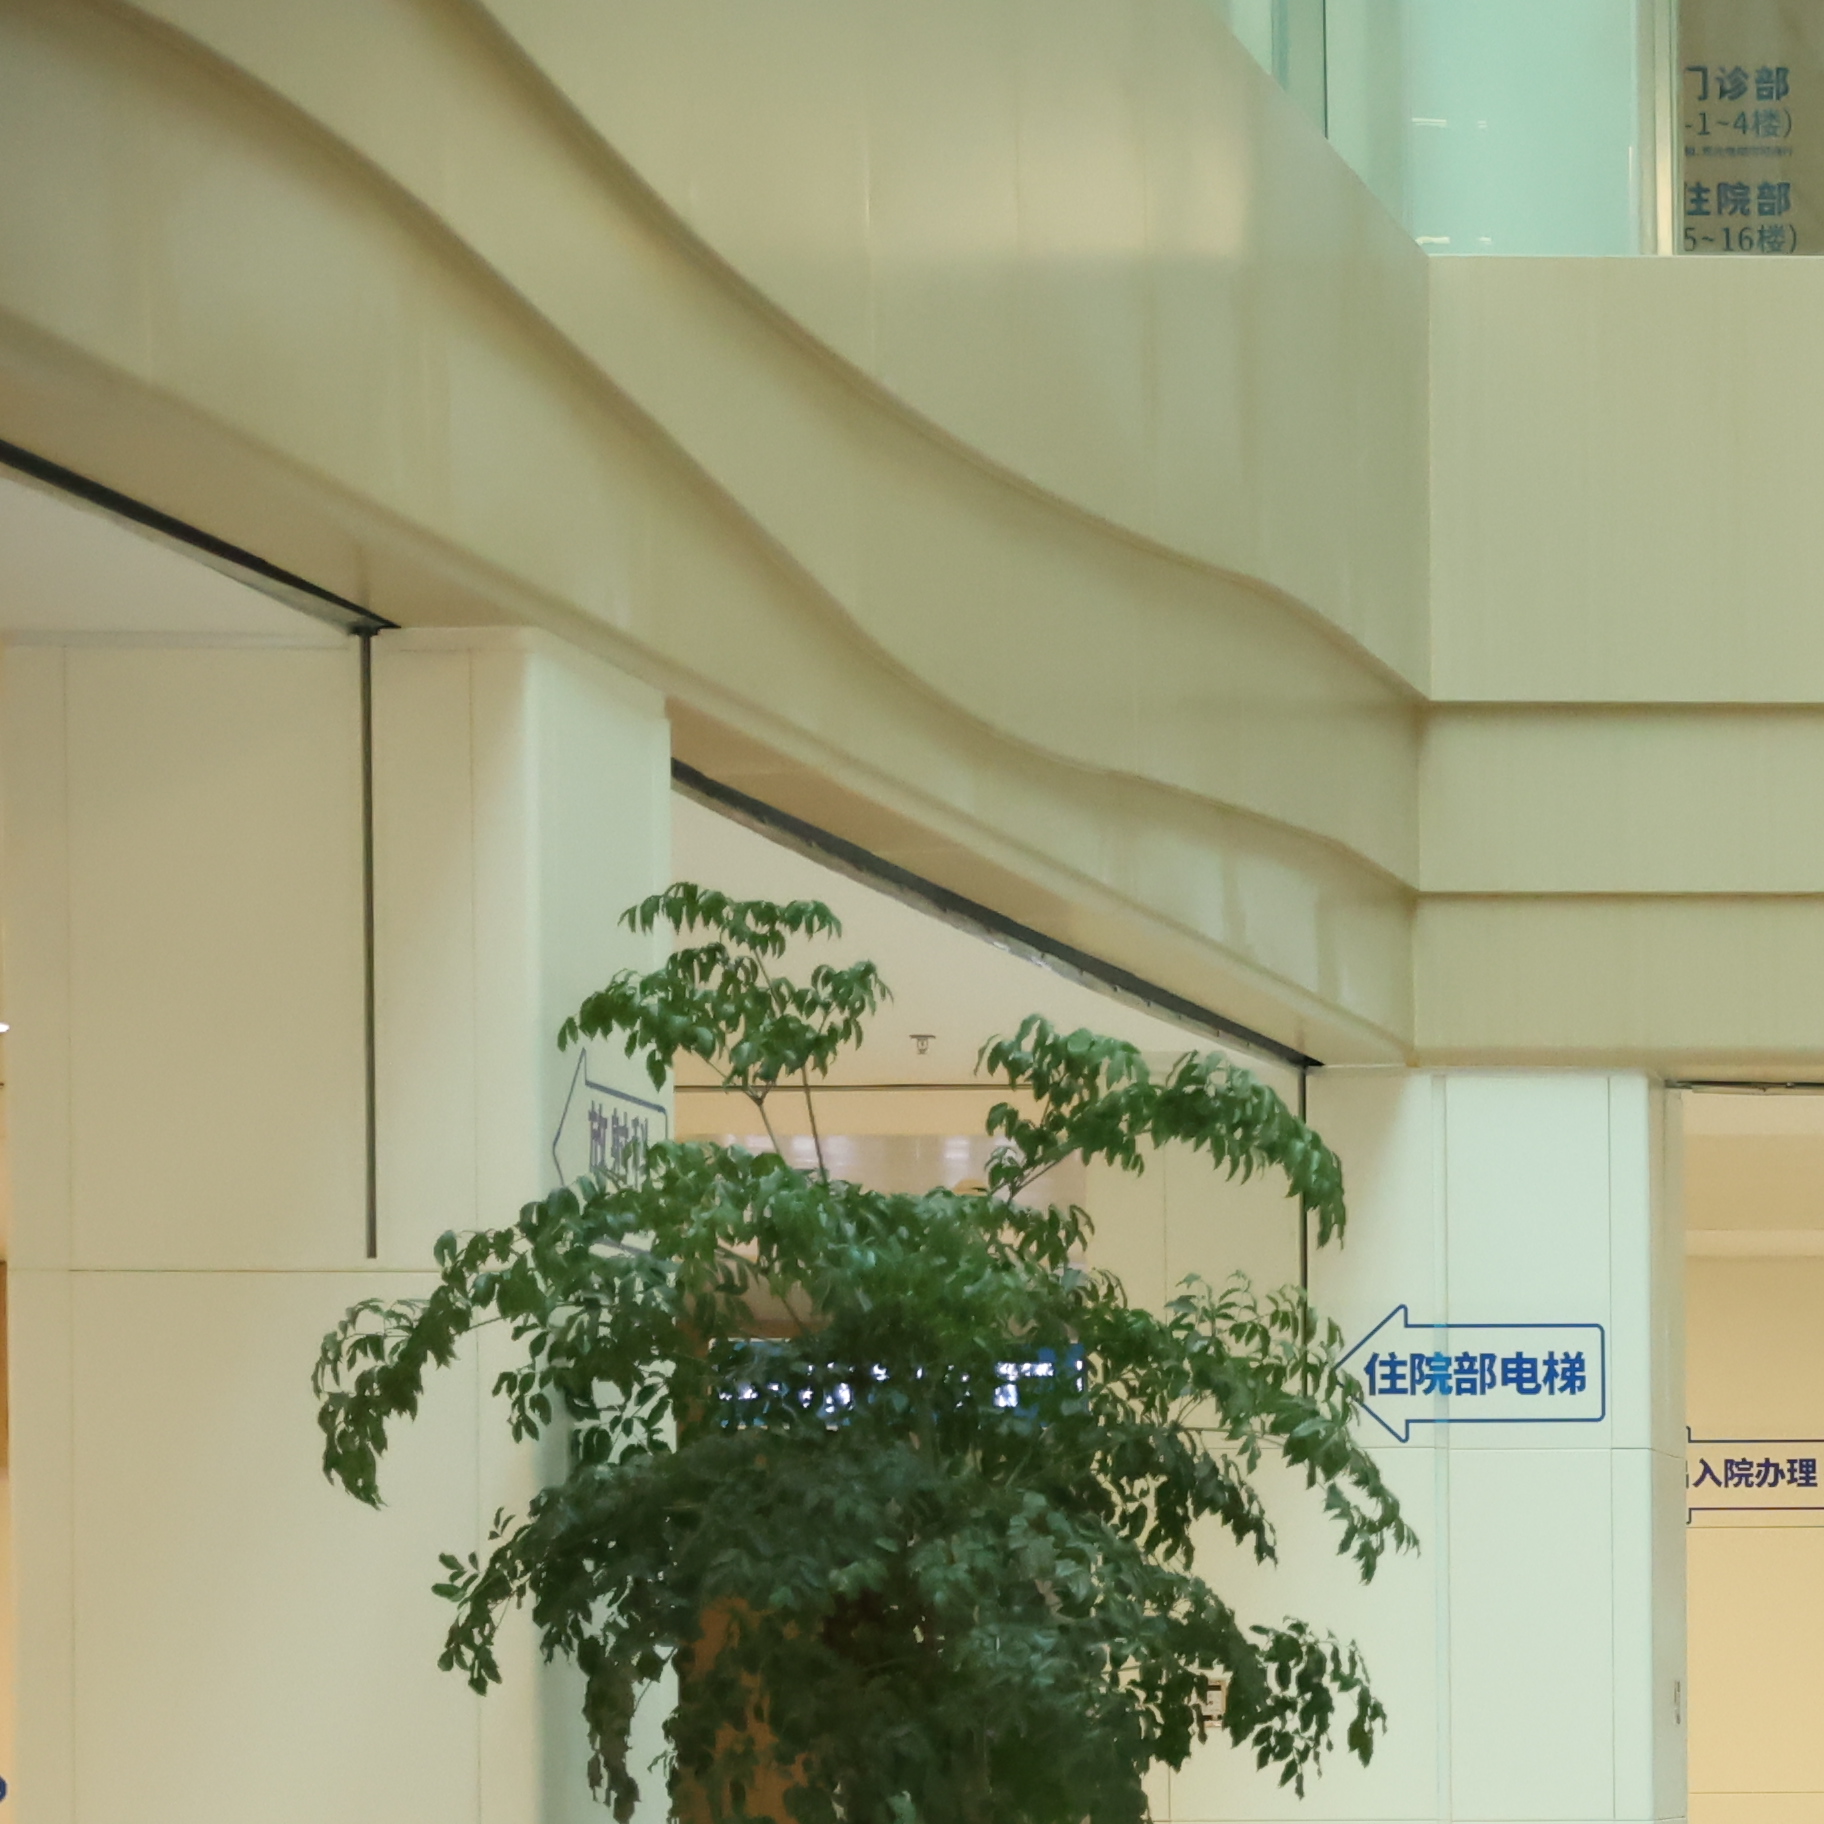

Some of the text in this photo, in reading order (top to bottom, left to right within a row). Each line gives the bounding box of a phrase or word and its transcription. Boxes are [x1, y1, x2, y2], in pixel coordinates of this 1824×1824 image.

[1364, 1351, 1586, 1396] 住院部电梯
[1686, 1457, 1818, 1488] 入院办理
